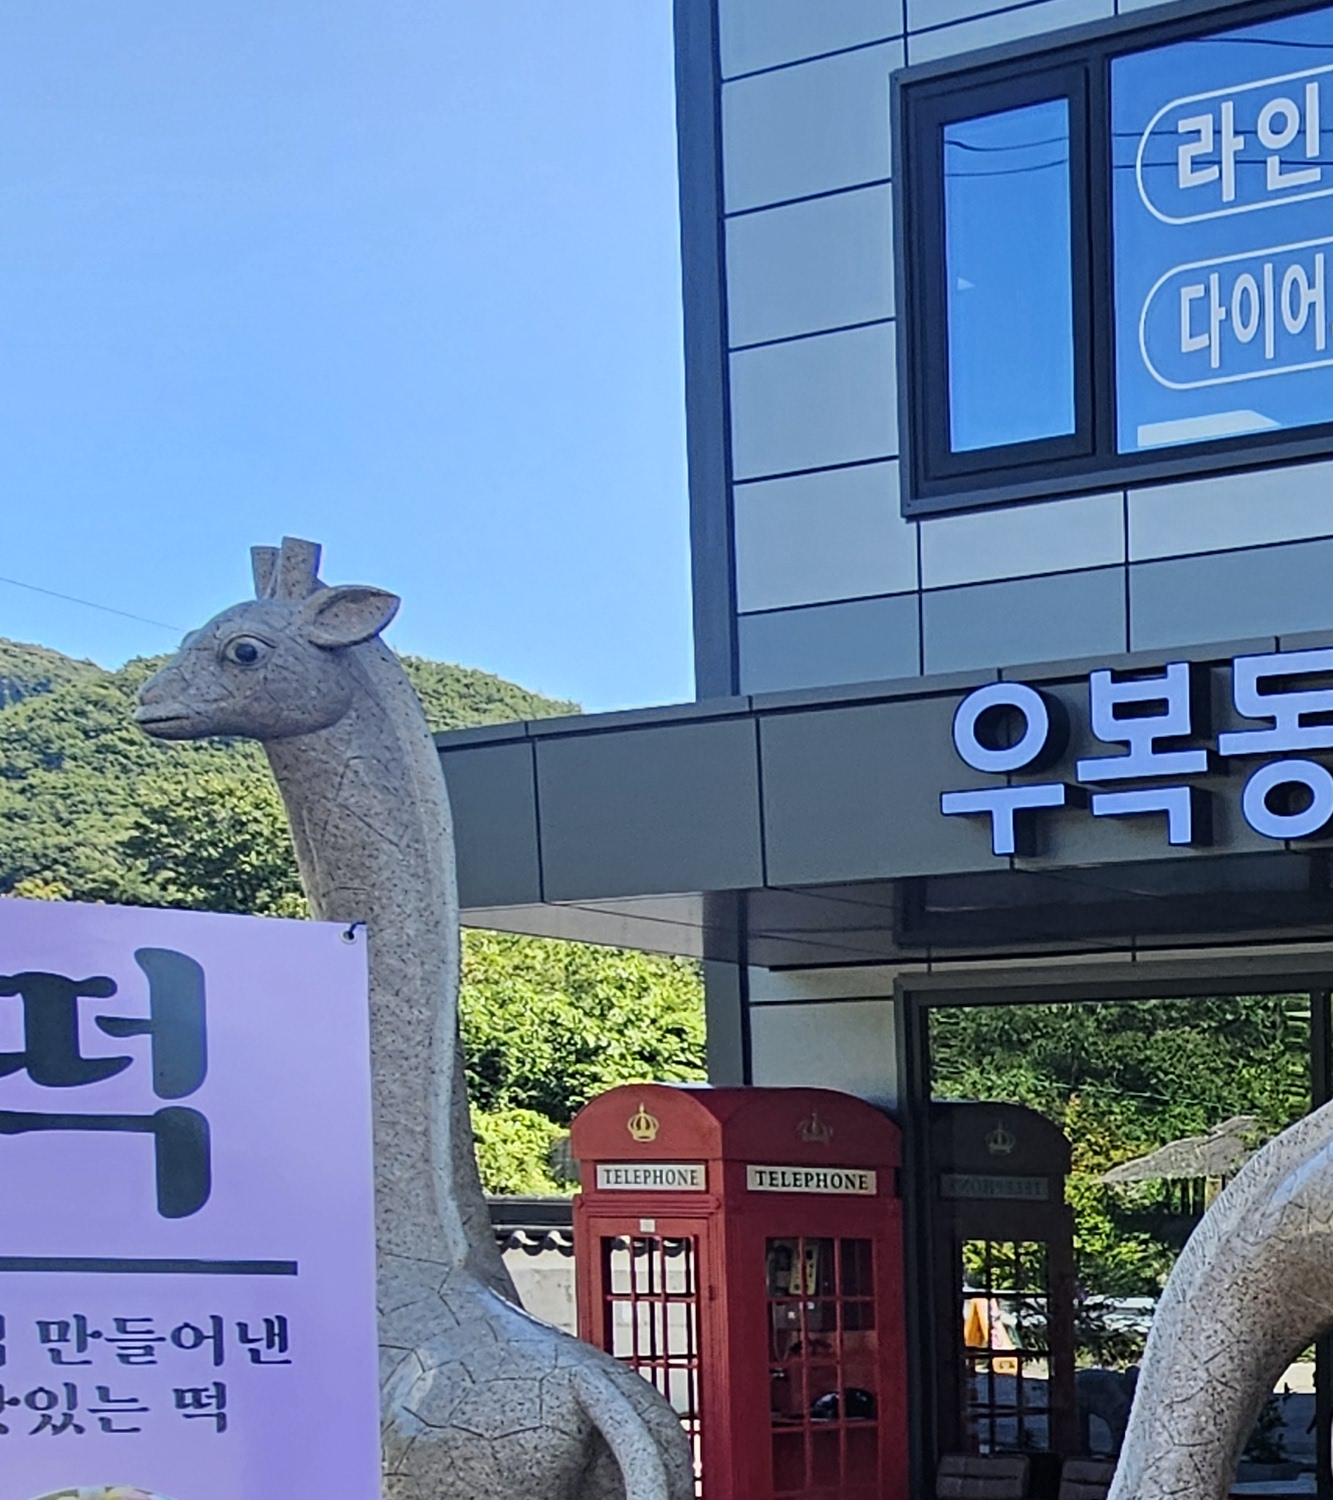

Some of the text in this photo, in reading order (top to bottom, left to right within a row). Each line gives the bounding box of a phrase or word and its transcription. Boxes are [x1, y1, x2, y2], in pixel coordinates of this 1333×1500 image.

[603, 1167, 700, 1187] TELEPHONE
[755, 1169, 870, 1191] TELEPHONE
[35, 1313, 292, 1367] 만들어낸
[0, 1381, 228, 1436] 있는 떡
